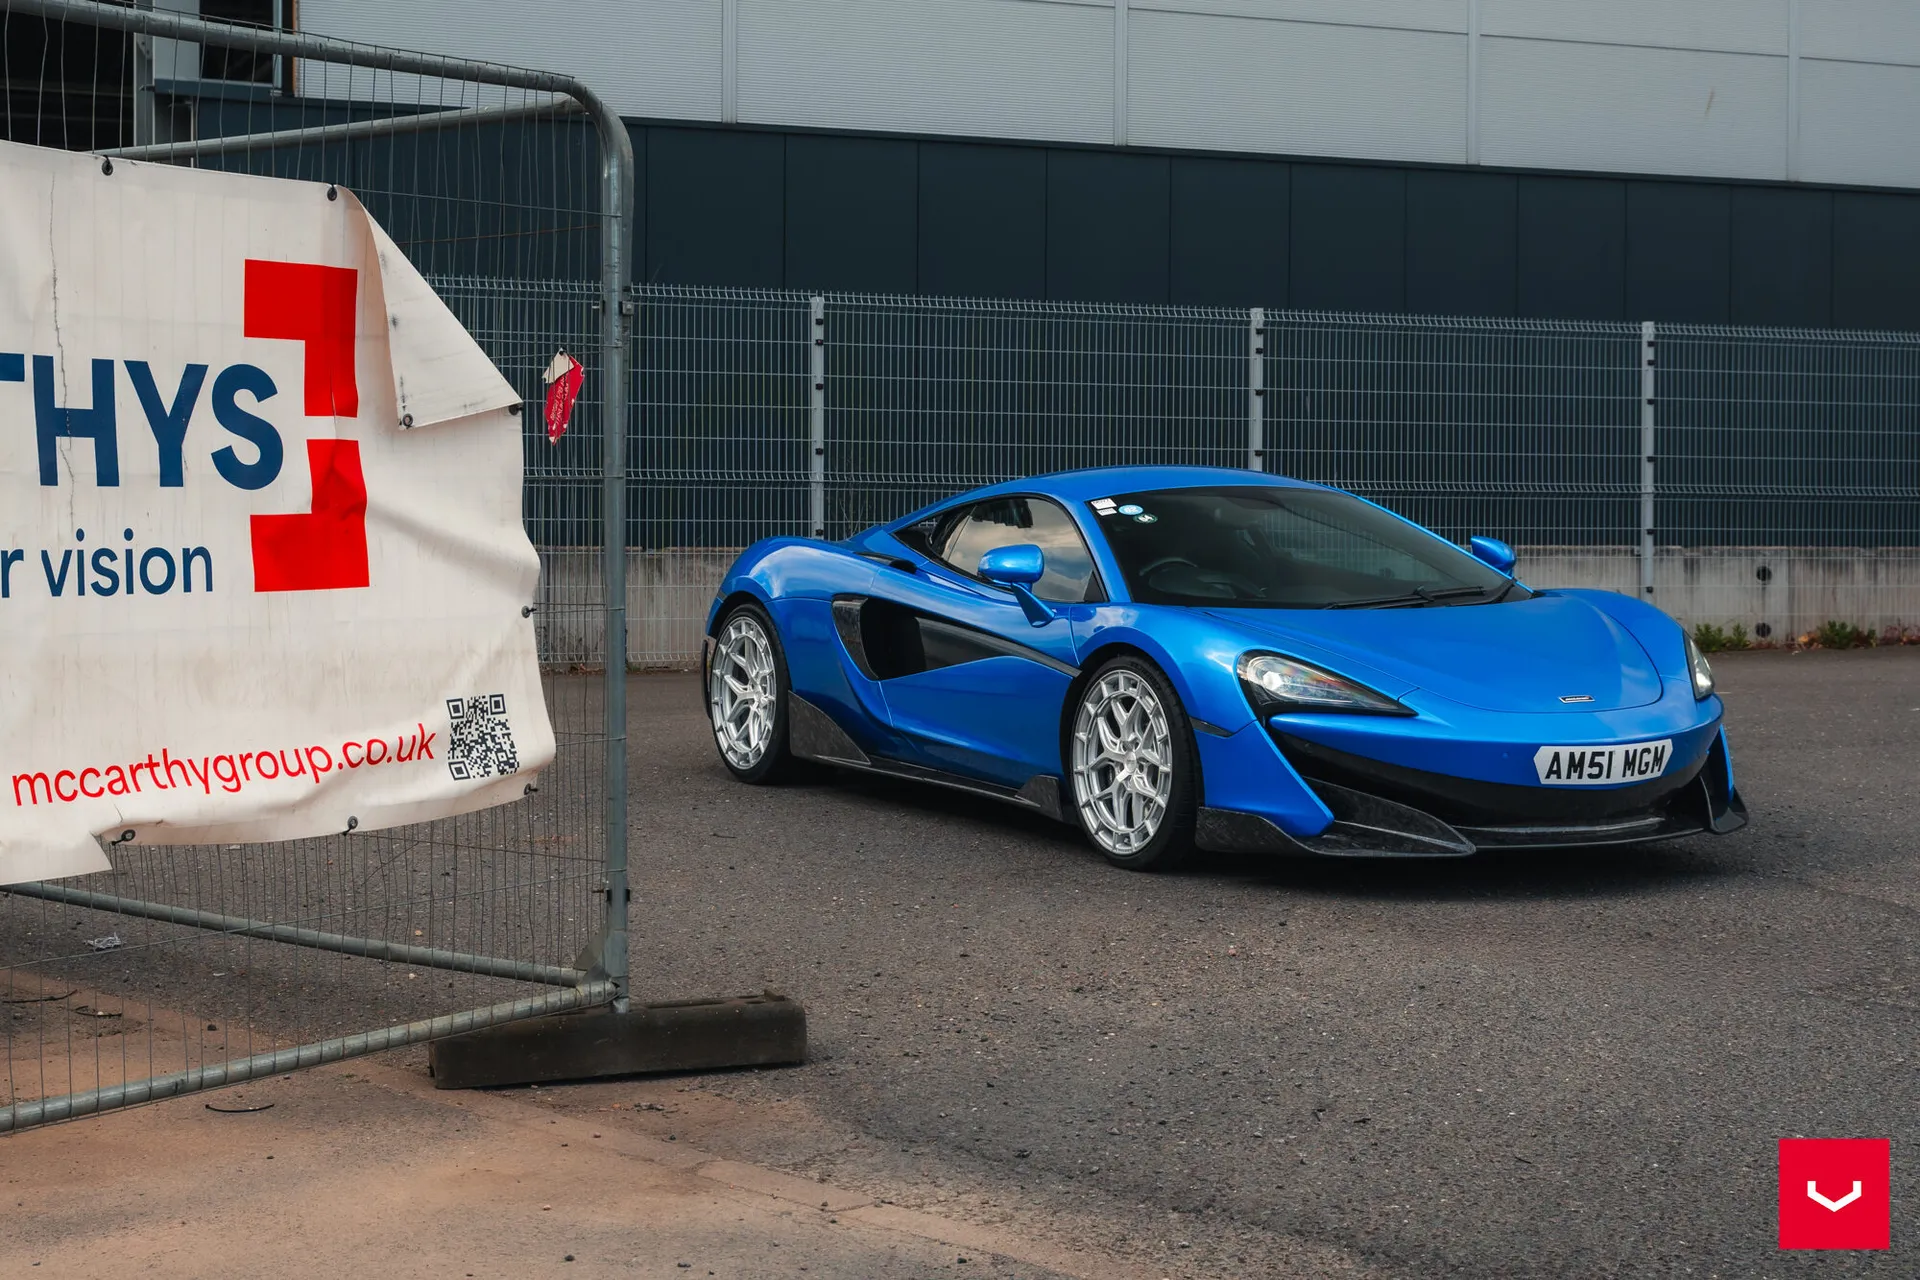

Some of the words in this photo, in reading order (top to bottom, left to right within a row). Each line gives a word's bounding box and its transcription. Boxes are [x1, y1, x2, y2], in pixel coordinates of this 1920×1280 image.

[40, 527, 213, 597] vision
[11, 722, 436, 807] mccarthygroup.co.uk
[1544, 750, 1615, 780] AM51
[1621, 744, 1666, 778] MGM
